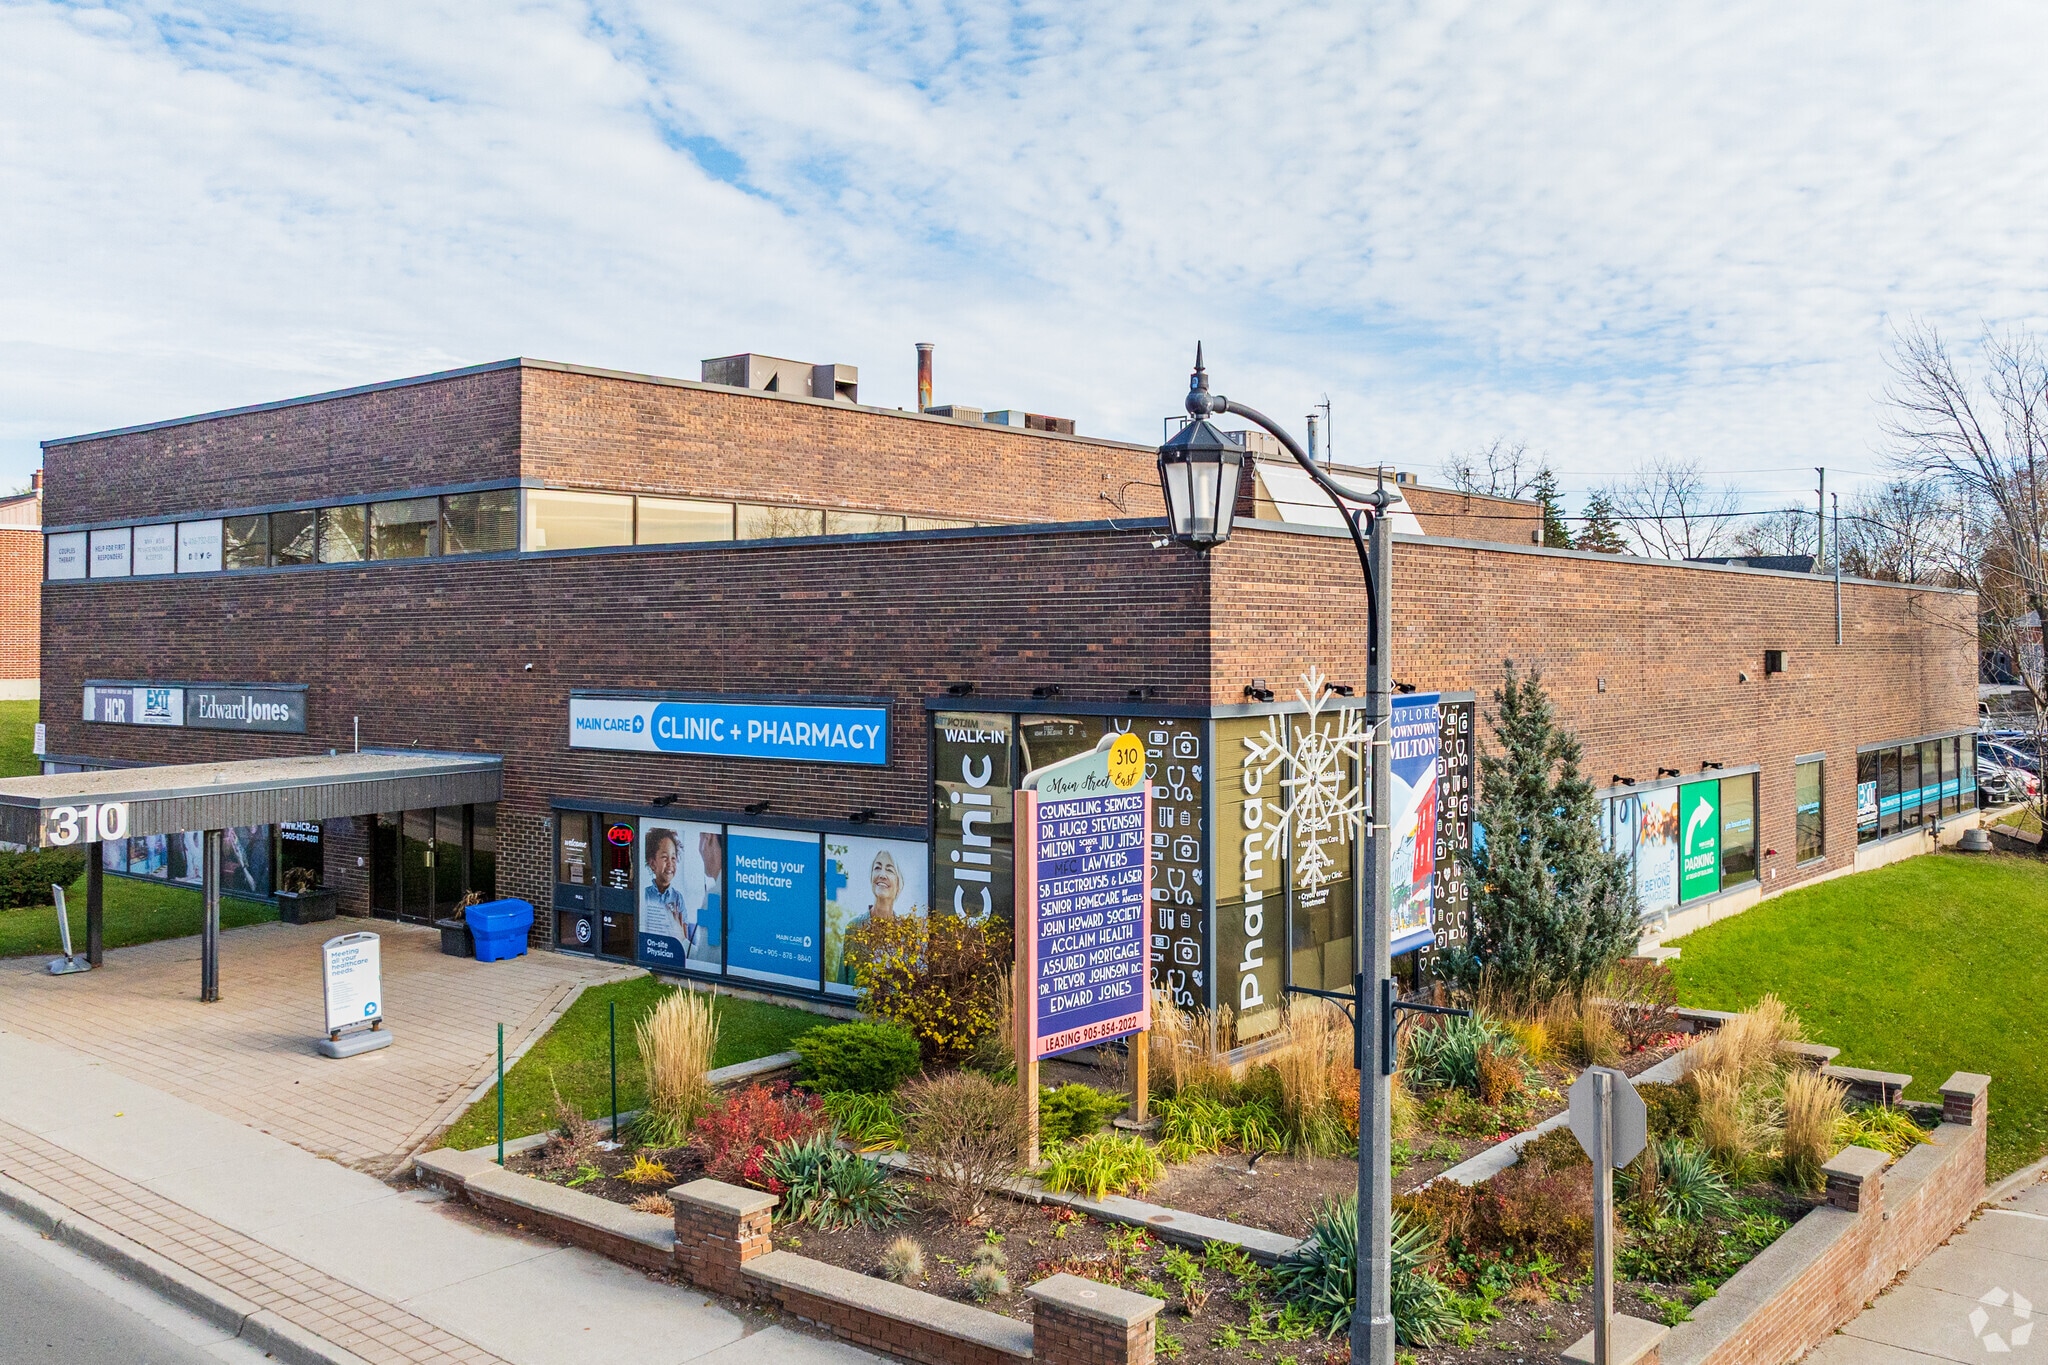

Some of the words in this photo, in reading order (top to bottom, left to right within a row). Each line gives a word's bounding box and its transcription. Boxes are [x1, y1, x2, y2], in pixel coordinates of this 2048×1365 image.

[105, 698, 125, 722] HCR
[576, 718, 600, 730] MAIN
[604, 718, 630, 731] CARE
[658, 716, 724, 742] CLINIC
[748, 720, 880, 749] PHARMACY
[944, 729, 1005, 744] WALK-IN
[1116, 748, 1138, 765] 310
[1046, 778, 1078, 794] Main
[1082, 769, 1112, 790] Street
[1115, 767, 1137, 786] East
[1040, 800, 1101, 819] COUNSELLING
[1104, 796, 1142, 812] SERVICES
[50, 803, 126, 845] 310
[1042, 824, 1055, 839] DR.
[1060, 820, 1087, 836] HUGO
[1092, 814, 1142, 832] STEVENSON
[564, 839, 587, 848] welcome
[611, 829, 634, 843] OPEN
[950, 754, 992, 928] Clinic
[1041, 840, 1075, 858] MILTON
[1079, 838, 1098, 846] SCHOOL
[1099, 834, 1114, 850] JIU
[1118, 831, 1142, 848] JITSU
[736, 855, 778, 873] Meeting
[781, 862, 805, 873] your
[1082, 852, 1127, 872] LAWYERS
[1654, 861, 1670, 876] CARE
[1685, 852, 1714, 872] PARKING
[736, 870, 792, 888] healthcare
[1240, 736, 1266, 1010] Pharmacy
[1645, 874, 1670, 892] BEYOND
[1040, 884, 1050, 898] SB
[1054, 874, 1109, 895] ELECTROLYSIS
[1111, 876, 1116, 886] &
[1119, 870, 1142, 885] LASER
[736, 888, 770, 902] needs.
[1041, 899, 1072, 916] SENIOR
[1075, 890, 1120, 910] HOMECARE
[1122, 894, 1142, 903] ANGELS
[1041, 920, 1065, 936] JOHN
[1069, 913, 1103, 932] HOWARD
[1107, 906, 1141, 924] SOCIETY
[647, 939, 668, 949] On-site
[1051, 932, 1095, 954] ACCLAIM
[1100, 924, 1132, 944] HEALTH
[332, 948, 359, 958] Meeting
[647, 947, 674, 958] Physician
[750, 946, 763, 955] Clinic
[1042, 954, 1085, 976] ASSURED
[1090, 942, 1140, 966] MORTGAGE
[332, 958, 368, 970] healthcare
[1040, 983, 1050, 995] DR.
[1053, 973, 1085, 991] TREVOR
[1089, 962, 1128, 983] JOHNSON
[1050, 990, 1093, 1013] EDWARD
[1098, 980, 1132, 1000] JONES
[1046, 1031, 1080, 1051] LEASING
[1084, 1016, 1137, 1040] 905-854-2022
